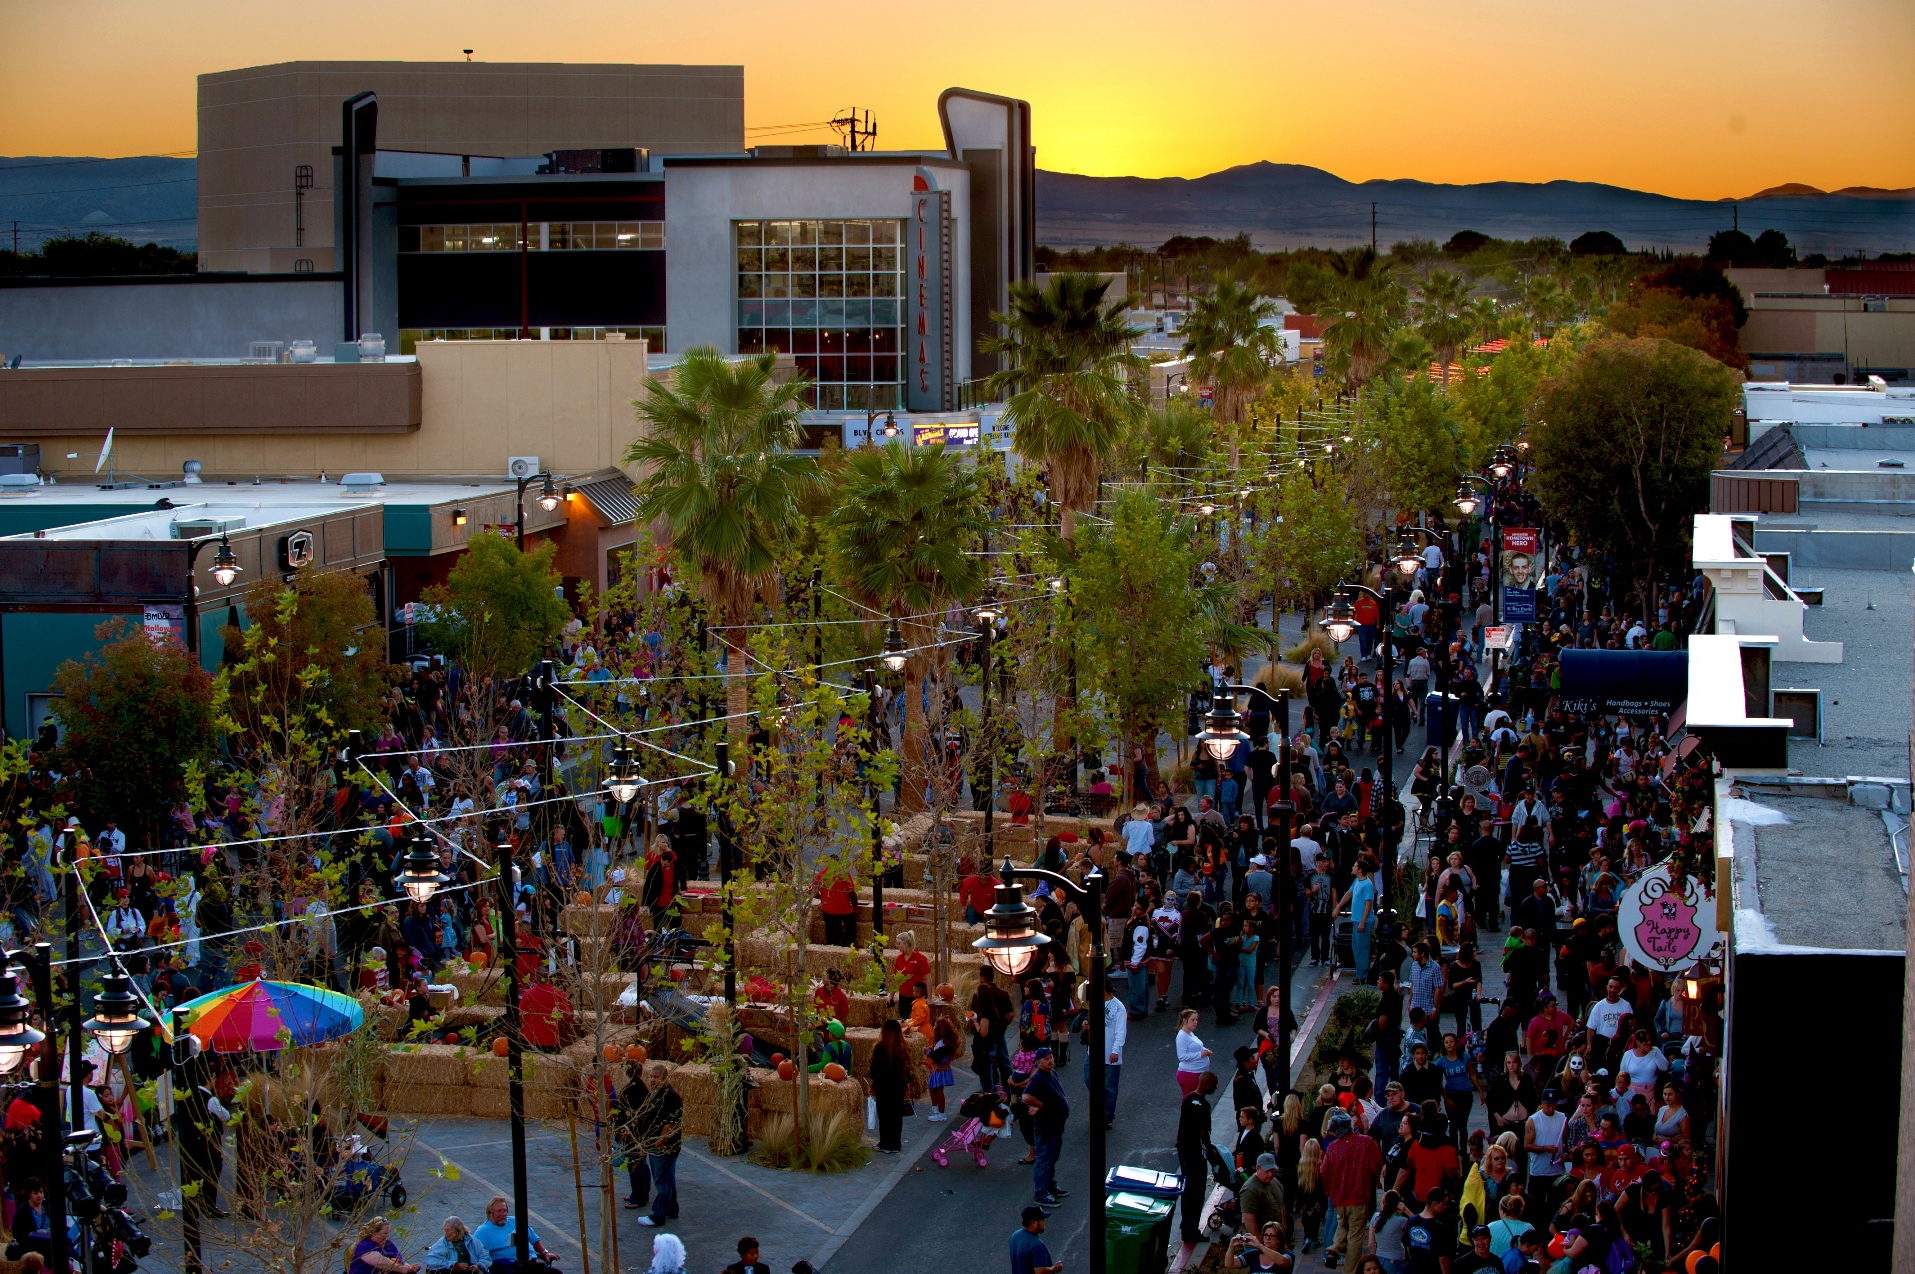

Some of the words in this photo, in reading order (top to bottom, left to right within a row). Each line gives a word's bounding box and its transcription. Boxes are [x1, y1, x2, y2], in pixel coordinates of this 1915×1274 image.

[917, 198, 930, 392] CINEMAS
[1562, 698, 1597, 713] Kiki's
[1618, 707, 1659, 715] Accessories
[1646, 919, 1690, 940] Happy
[1647, 936, 1677, 953] Tails
